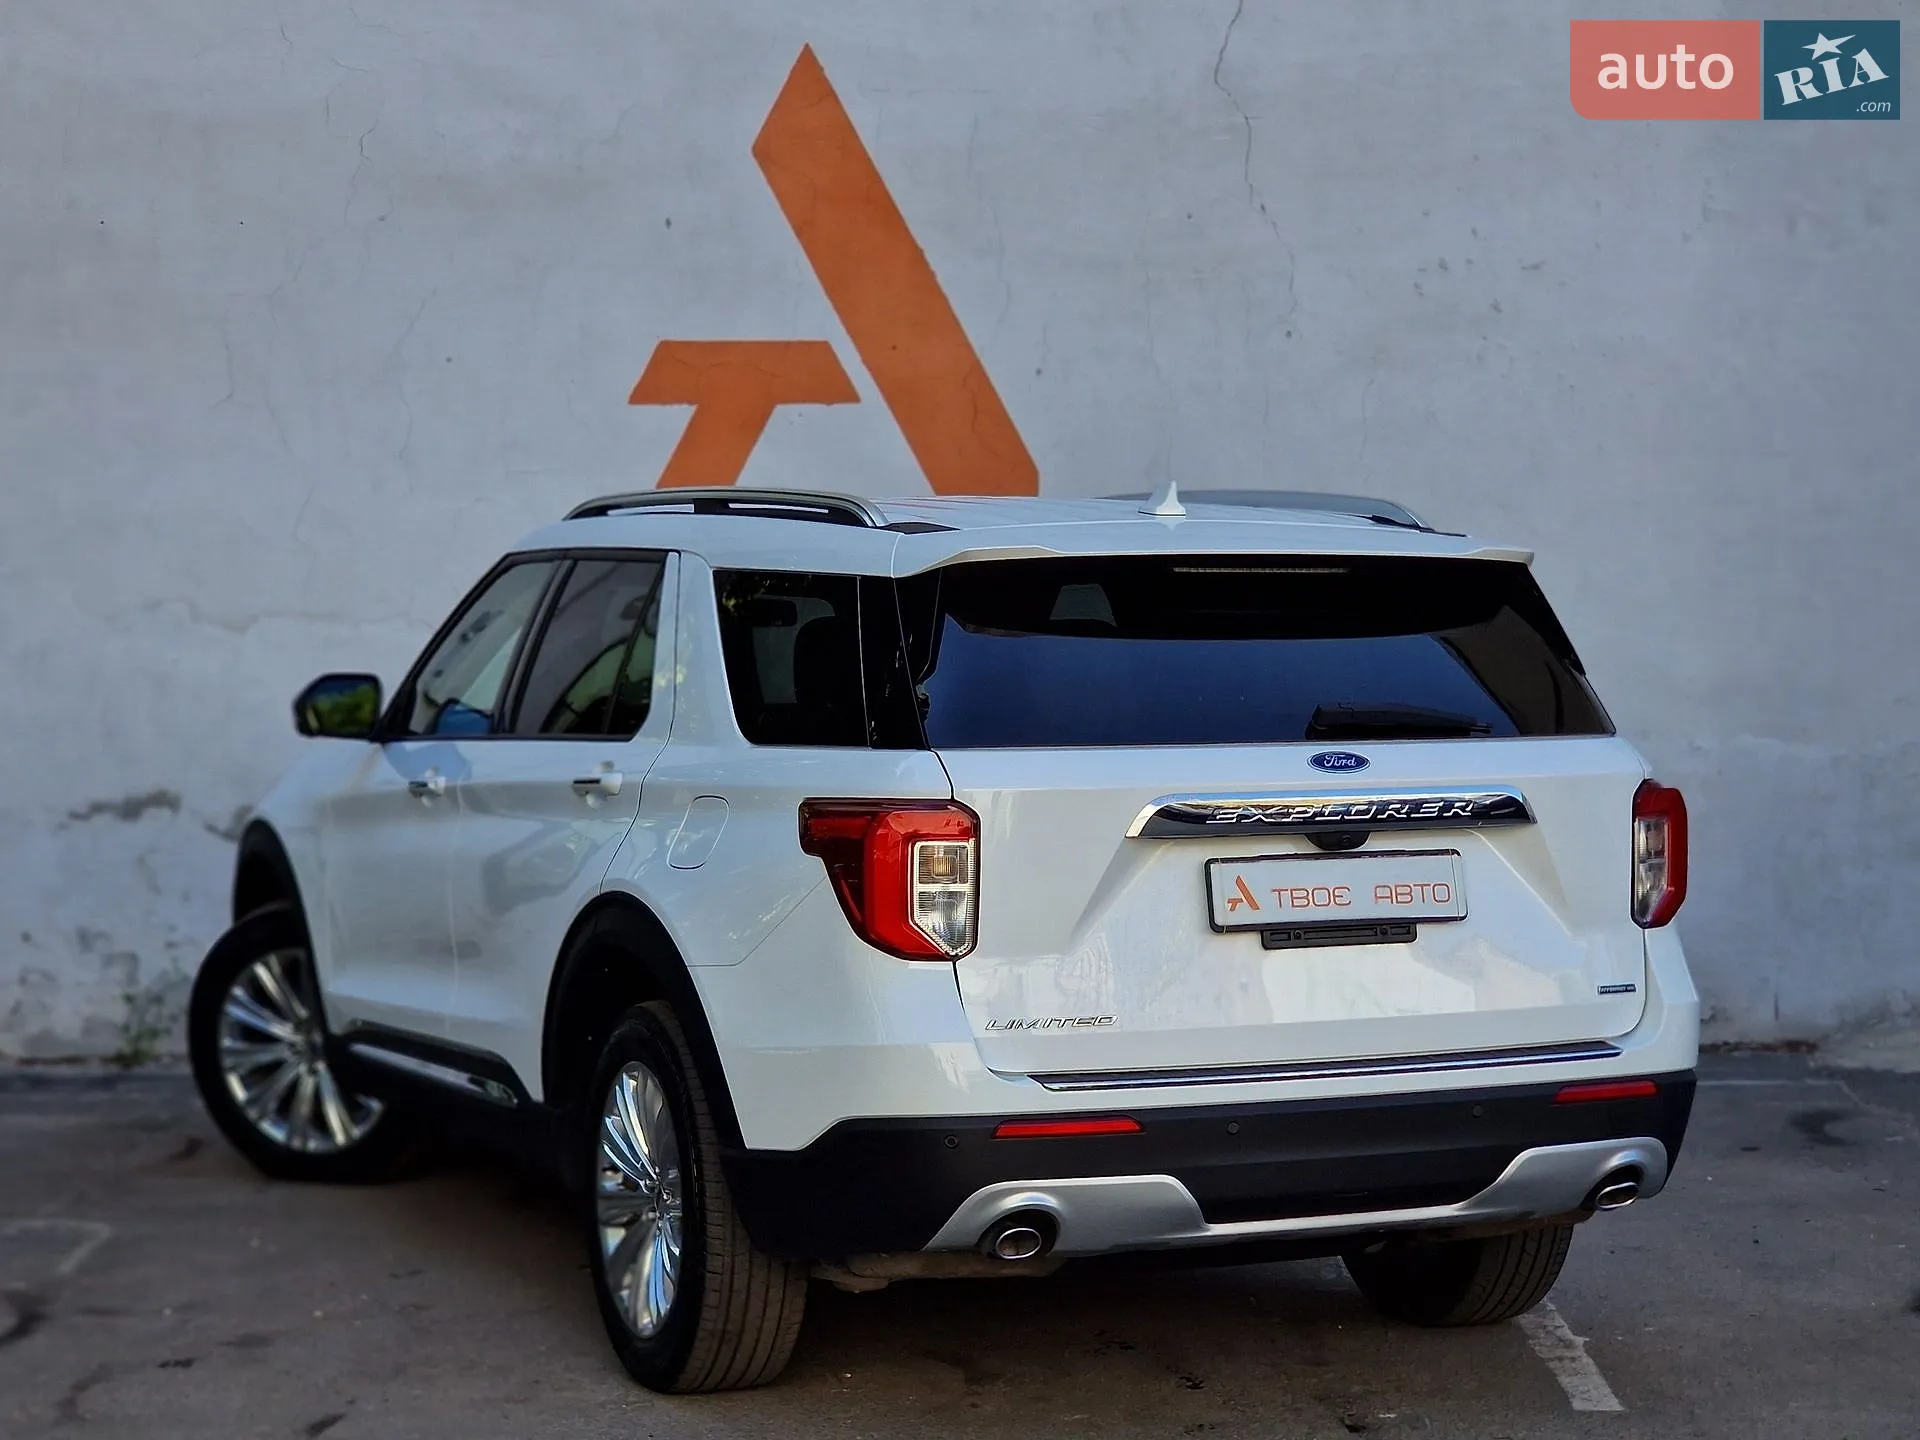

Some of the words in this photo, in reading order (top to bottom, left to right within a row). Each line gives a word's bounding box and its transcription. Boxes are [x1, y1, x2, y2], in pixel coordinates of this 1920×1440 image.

[1323, 753, 1357, 767] Ford
[1205, 801, 1475, 825] EXPLORER
[1270, 886, 1352, 909] ТВОЄ
[1374, 883, 1452, 905] АВТО
[985, 1014, 1118, 1031] LIMITED
